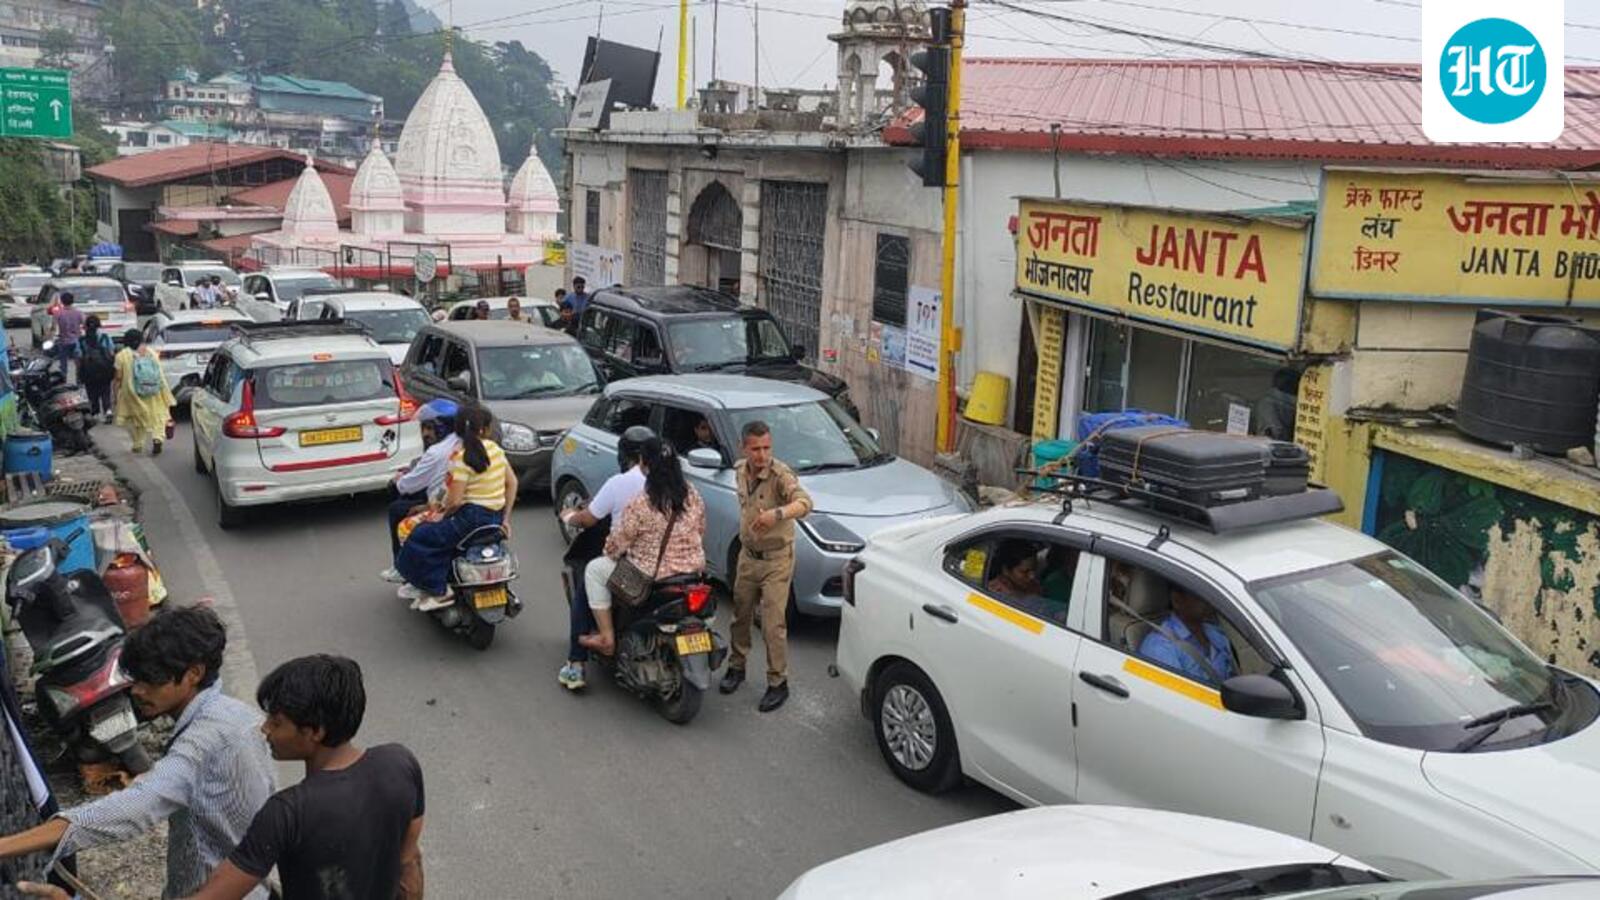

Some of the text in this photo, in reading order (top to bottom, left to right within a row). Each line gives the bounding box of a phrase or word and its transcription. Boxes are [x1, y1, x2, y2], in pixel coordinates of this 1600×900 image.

[1379, 187, 1424, 211] फास्ट
[1027, 210, 1102, 257] जनता
[1361, 213, 1402, 239] लंच
[1447, 200, 1554, 236] जनता
[1136, 224, 1267, 283] JANTA
[1354, 245, 1401, 273] डिनर
[1461, 246, 1541, 277] JANTA
[1025, 251, 1094, 296] भोजनालय
[1128, 272, 1258, 328] Restaurant
